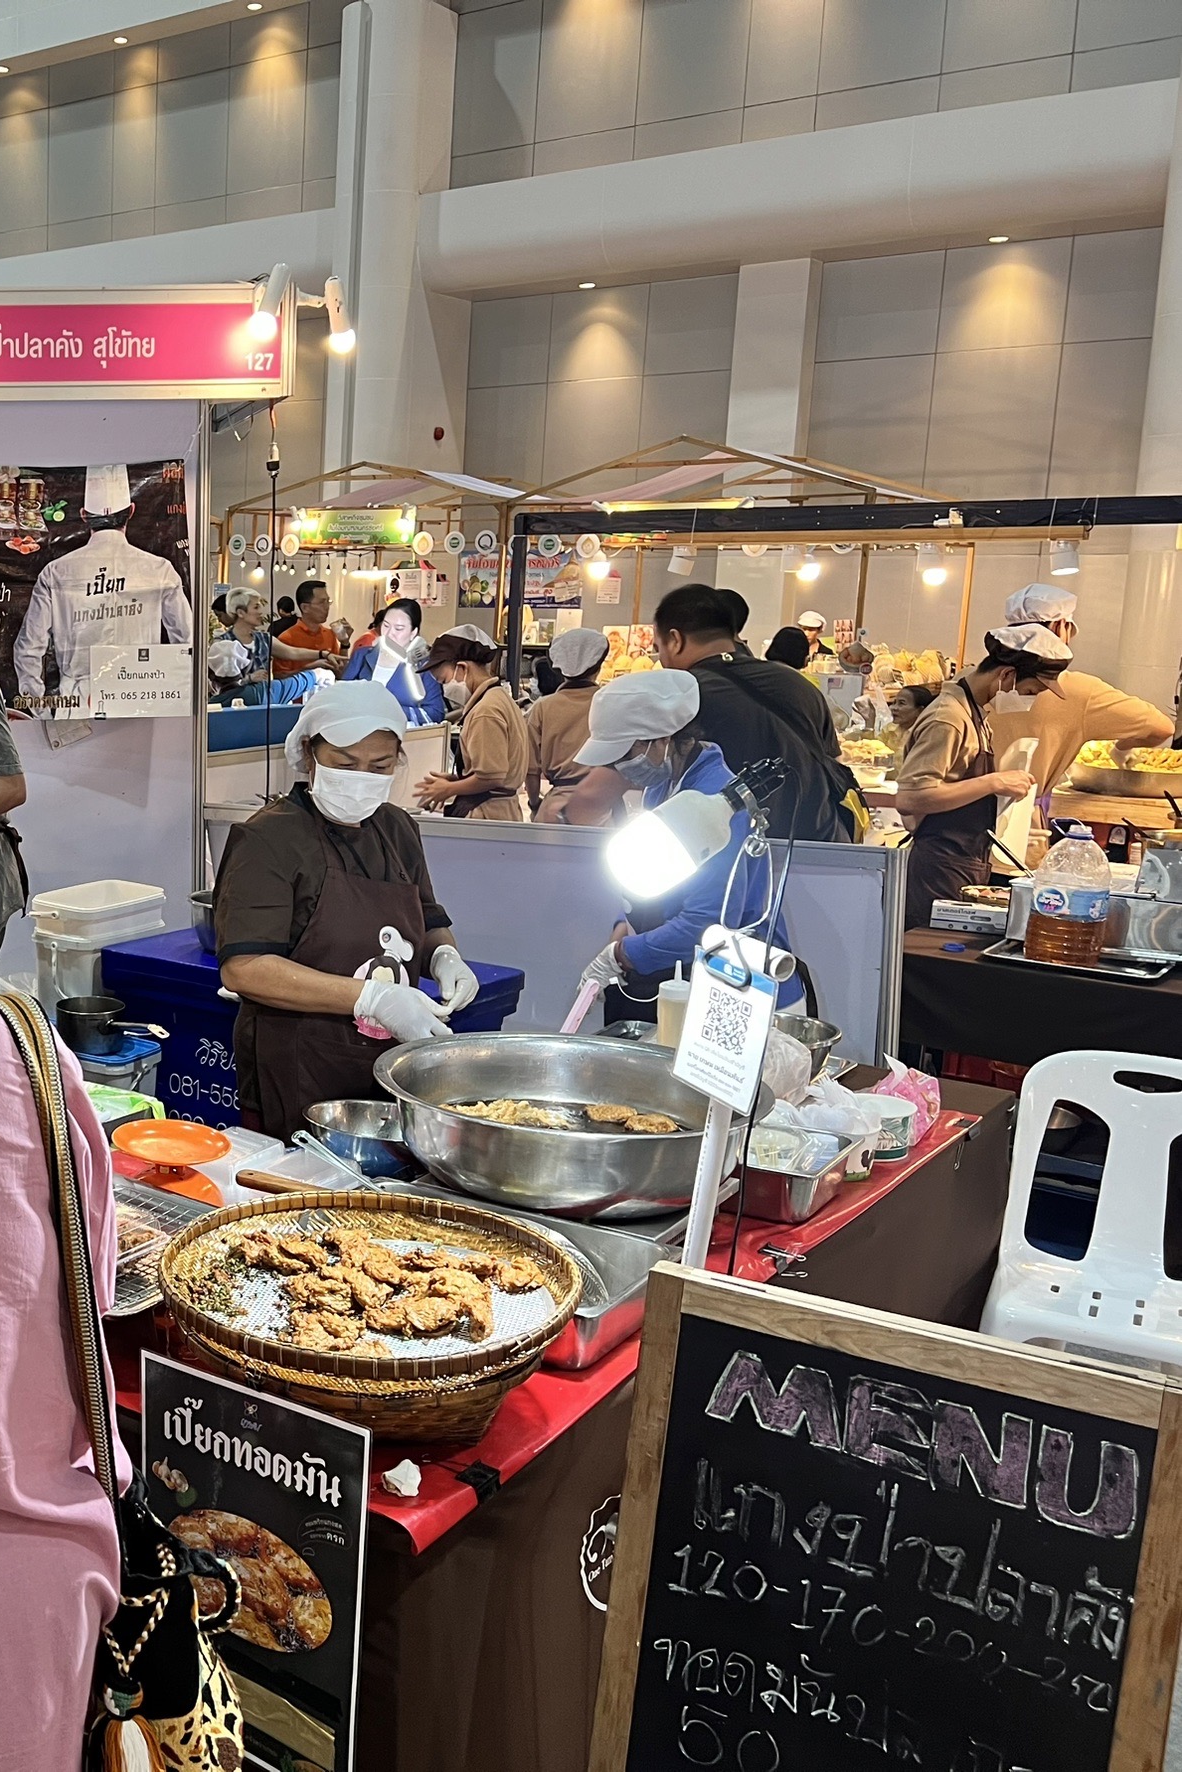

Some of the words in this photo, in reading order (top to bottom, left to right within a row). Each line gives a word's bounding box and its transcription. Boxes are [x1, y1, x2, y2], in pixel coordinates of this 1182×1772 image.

[245, 352, 274, 371] 127
[85, 567, 126, 597] เปี๊ยก
[121, 692, 137, 700] 065
[140, 691, 157, 700] 218
[160, 691, 181, 699] 1861
[163, 1396, 342, 1507] เปี๊ยกทอดมัน
[705, 1350, 1140, 1540] MENU
[588, 1567, 601, 1582] One
